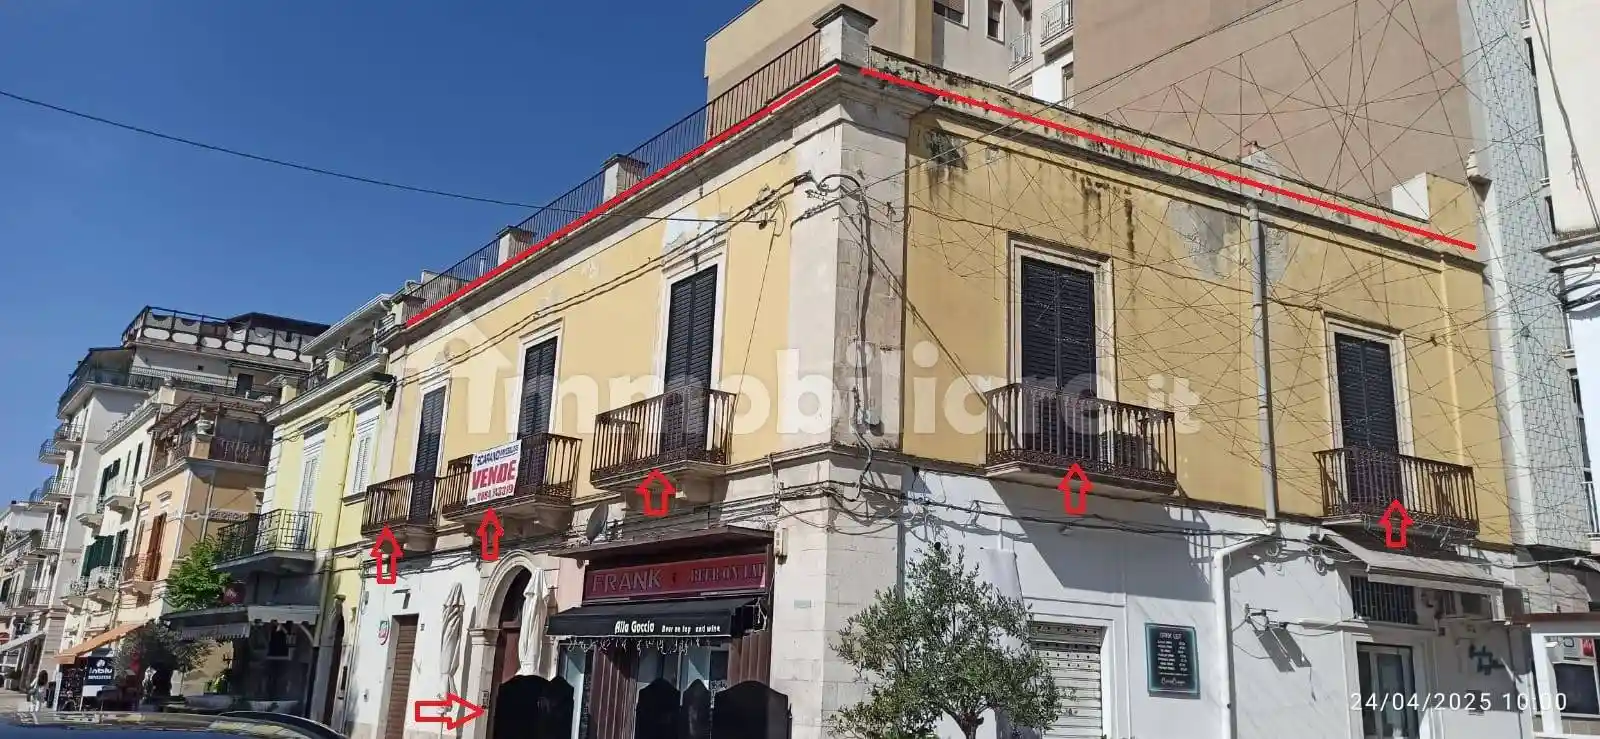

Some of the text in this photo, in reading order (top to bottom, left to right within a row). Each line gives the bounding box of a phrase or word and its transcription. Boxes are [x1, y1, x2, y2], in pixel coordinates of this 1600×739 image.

[472, 460, 516, 490] VENDE
[592, 569, 662, 593] FRANK
[631, 620, 655, 634] Goccia
